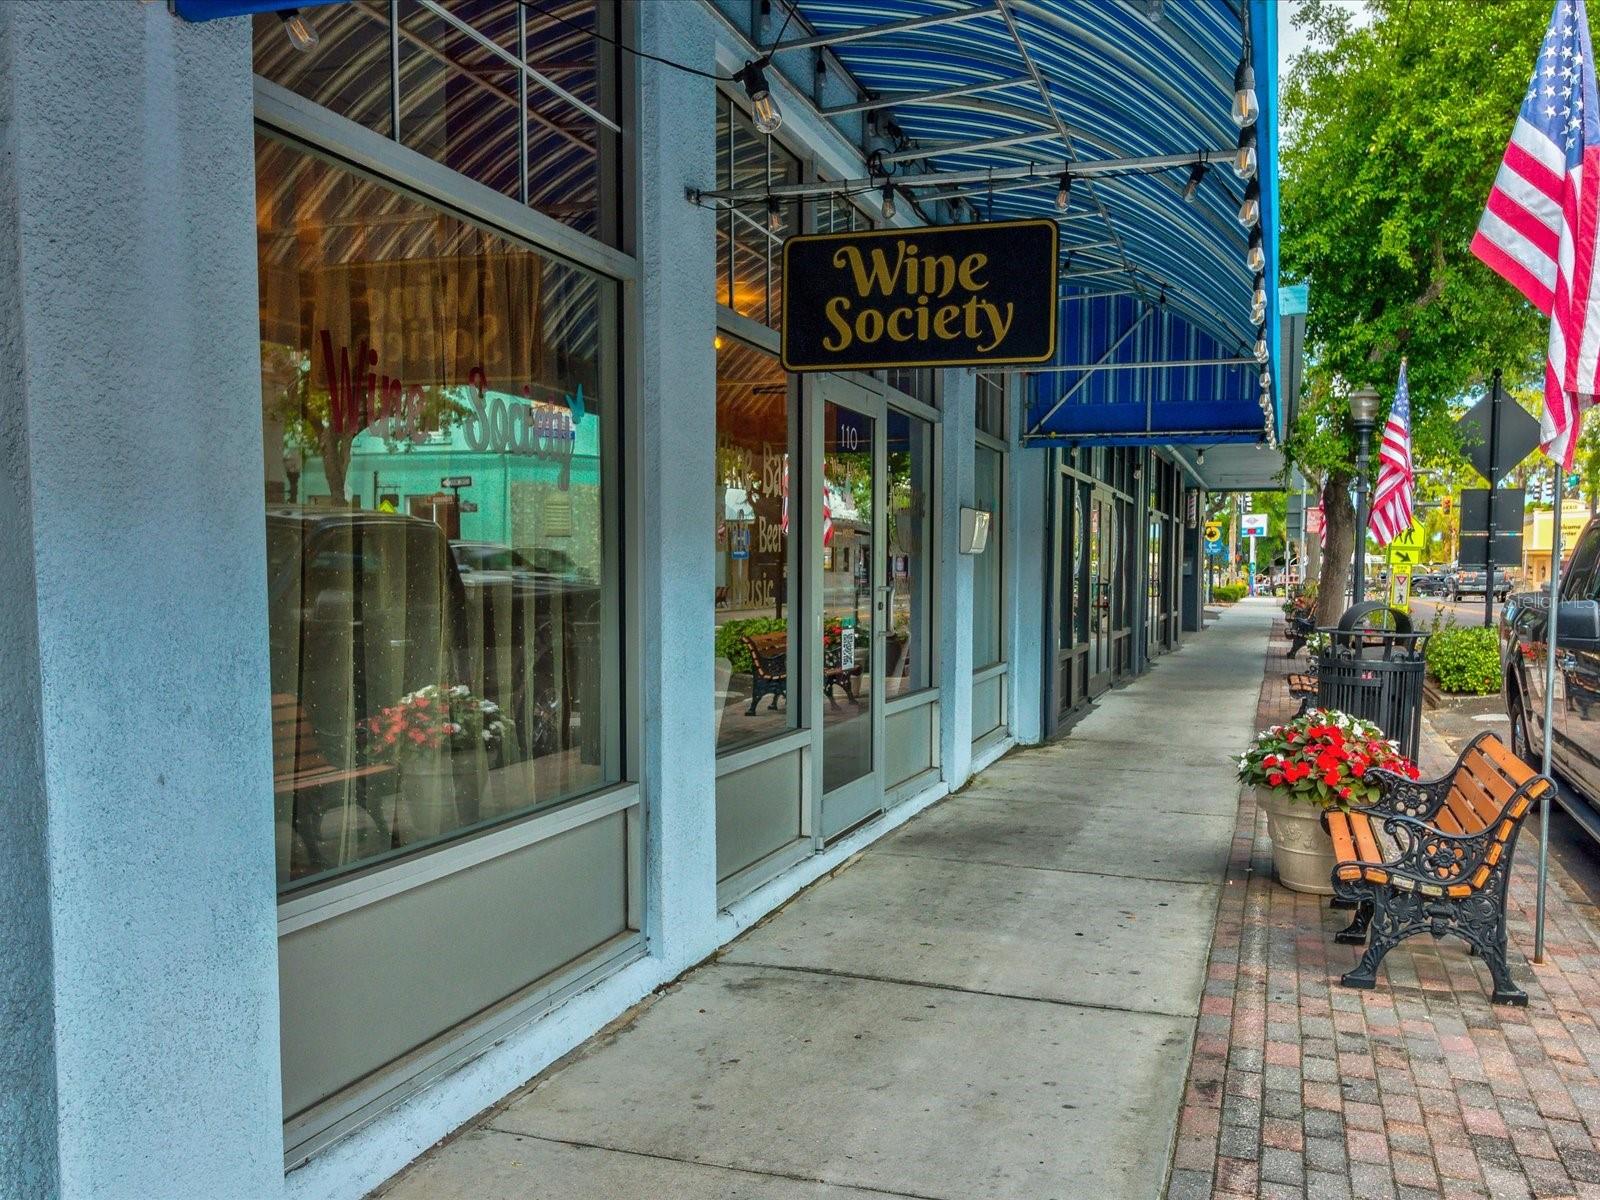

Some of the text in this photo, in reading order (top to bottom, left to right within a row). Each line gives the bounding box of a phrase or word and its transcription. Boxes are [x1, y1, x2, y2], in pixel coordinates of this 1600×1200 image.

[833, 240, 989, 298] Wine
[822, 295, 1014, 352] Society
[841, 424, 858, 450] 110
[759, 516, 783, 553] Beer
